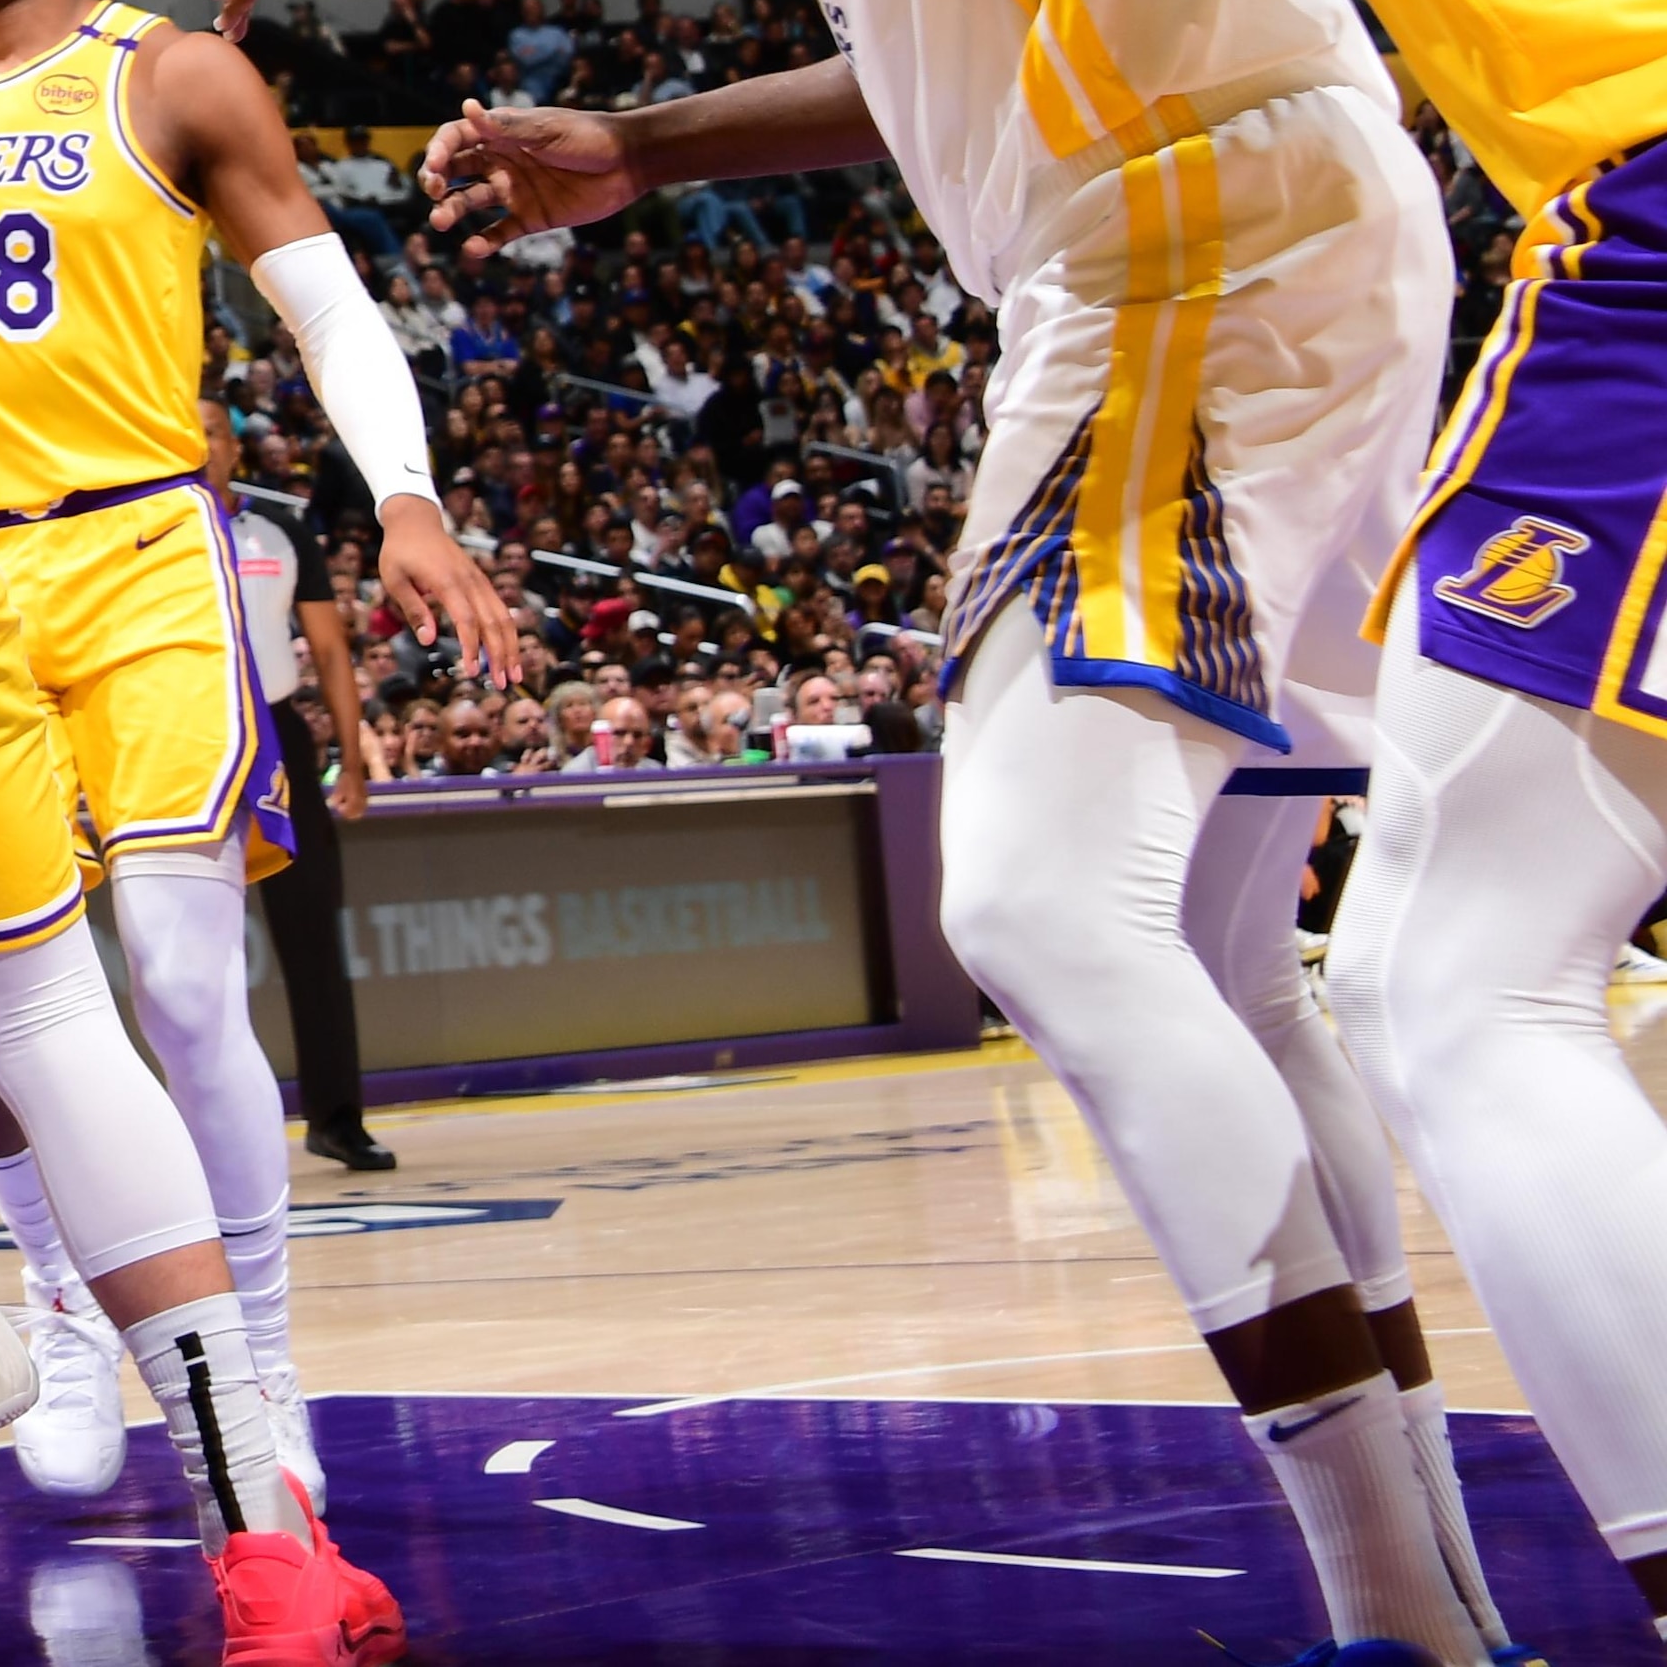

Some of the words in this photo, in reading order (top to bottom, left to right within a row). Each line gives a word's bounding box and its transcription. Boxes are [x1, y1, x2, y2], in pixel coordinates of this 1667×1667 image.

[40, 84, 94, 103] bibigo
[372, 891, 552, 975] THINGS
[557, 877, 831, 961] BASKETBALL
